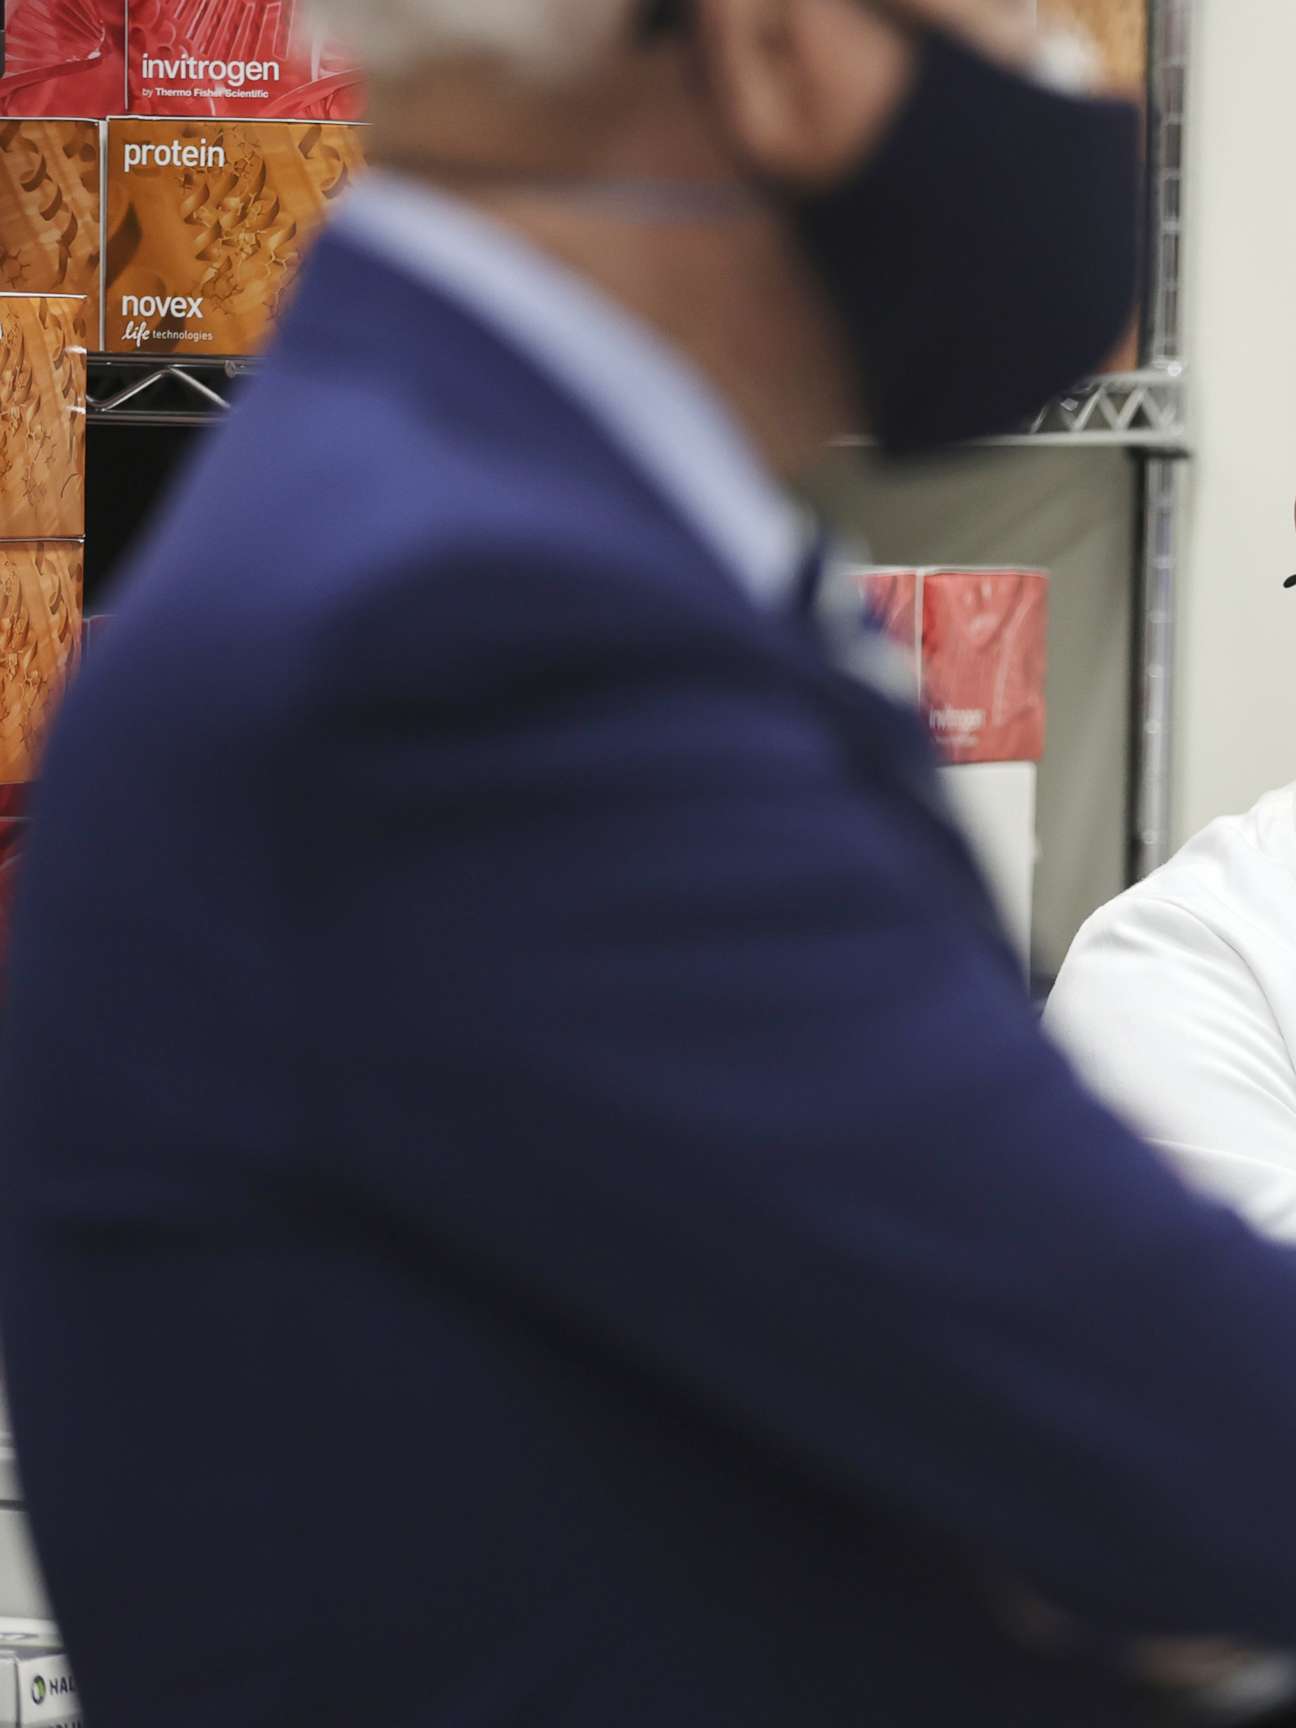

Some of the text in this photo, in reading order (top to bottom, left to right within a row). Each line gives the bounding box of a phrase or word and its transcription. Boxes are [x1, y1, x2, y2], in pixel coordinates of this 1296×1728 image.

[142, 53, 280, 87] invitrogen
[142, 88, 153, 98] by
[155, 87, 192, 97] Thermo
[224, 88, 269, 98] Scientific
[124, 139, 225, 172] protein
[121, 295, 204, 318] novex
[121, 320, 213, 347] life technologies
